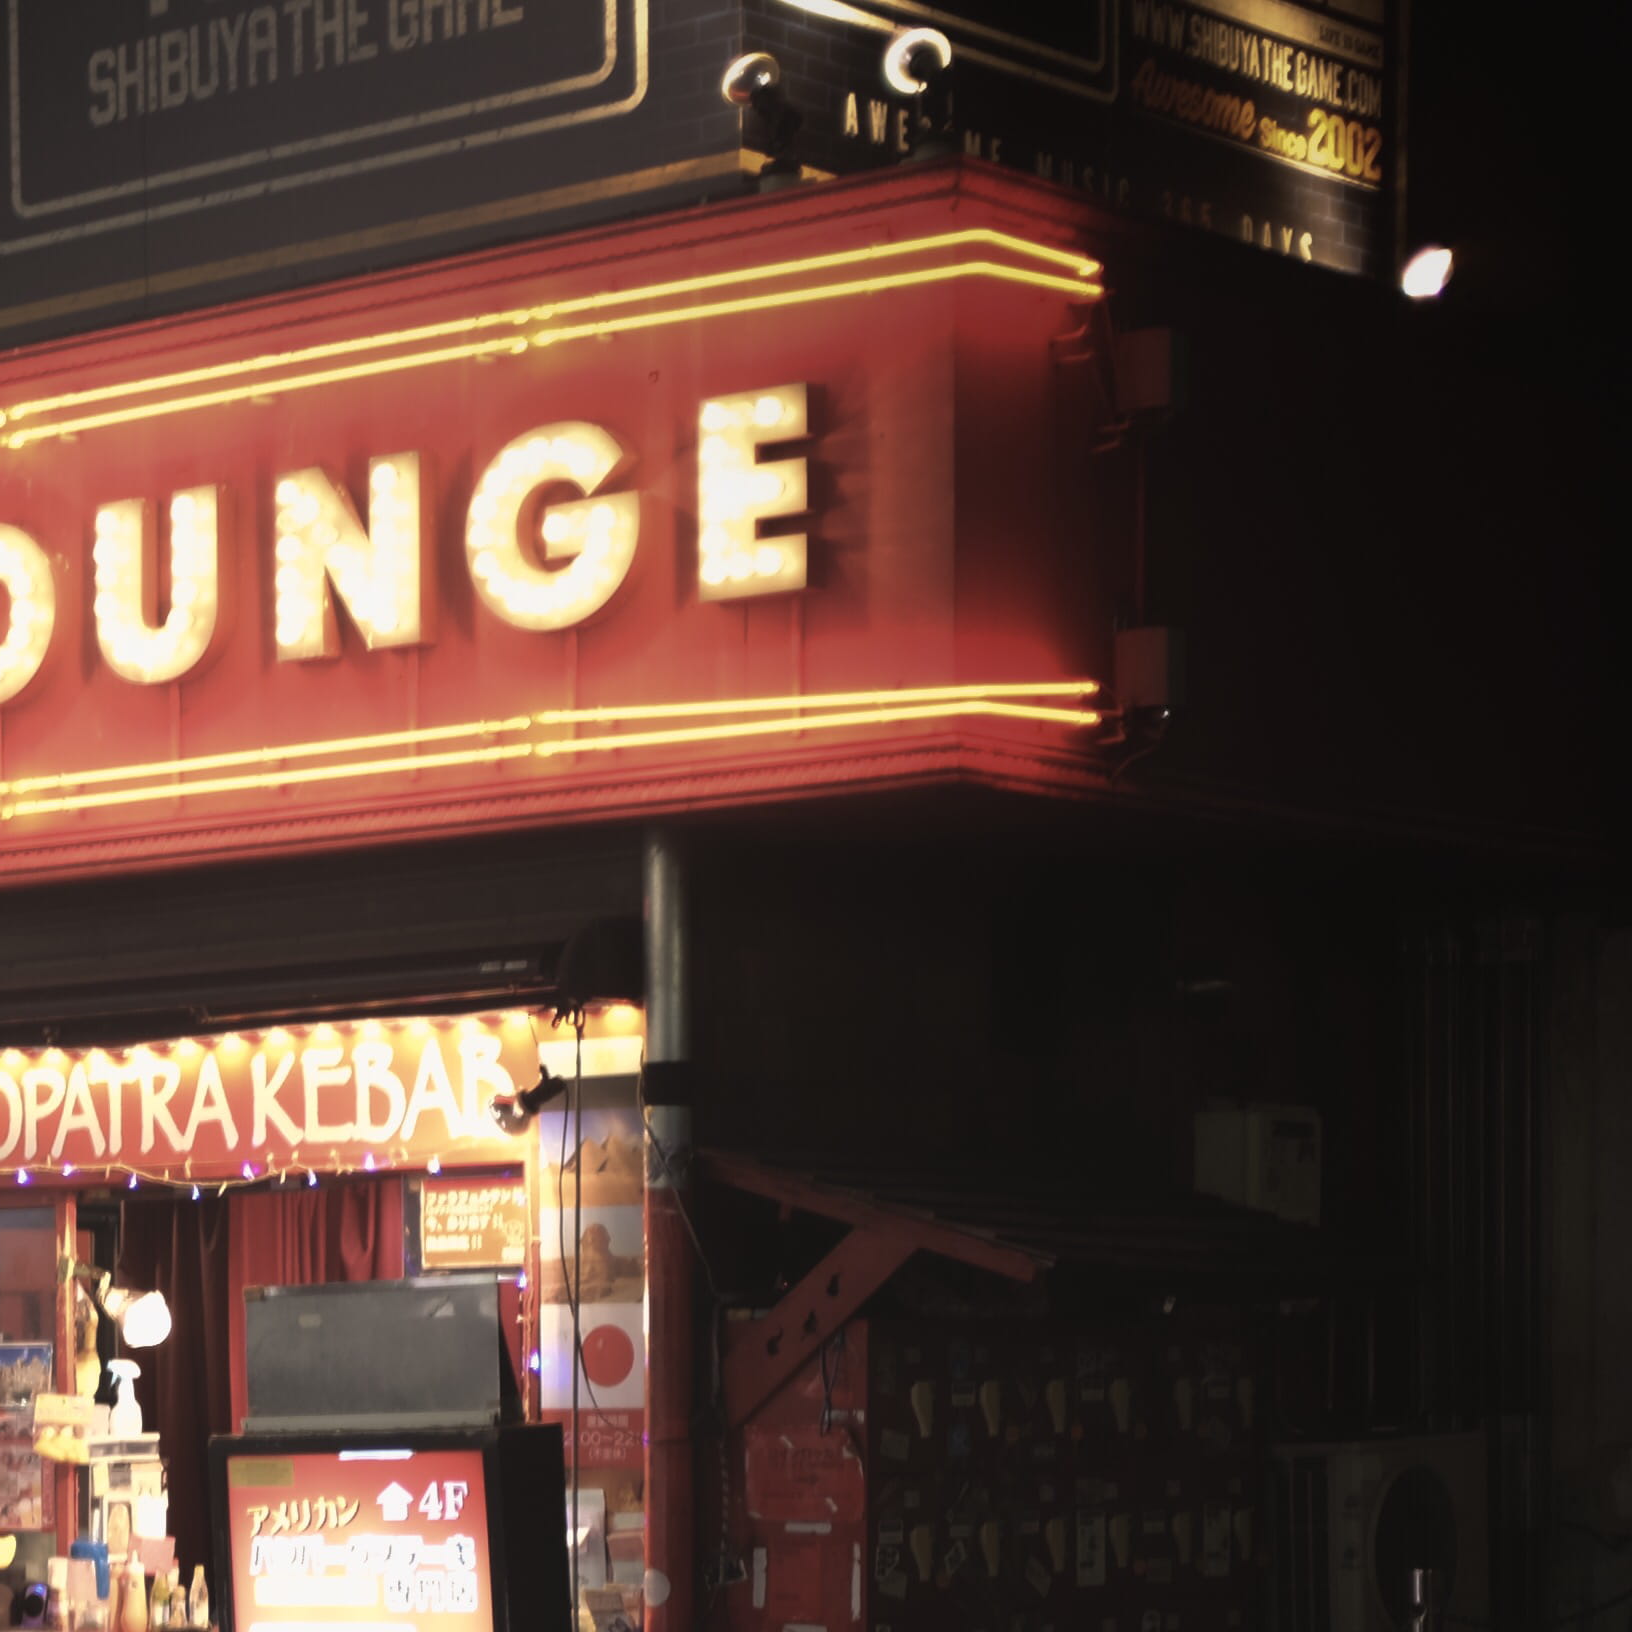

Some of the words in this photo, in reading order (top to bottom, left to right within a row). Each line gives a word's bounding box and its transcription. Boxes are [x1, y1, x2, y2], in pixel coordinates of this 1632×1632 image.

[88, 4, 279, 128] SHIBUYA
[283, 0, 379, 77] THE
[843, 92, 1003, 164] AWEME
[1259, 116, 1307, 161] Since
[1307, 107, 1385, 182] 2002
[251, 1033, 522, 1148] KEBAB
[247, 1495, 361, 1537] アメリカン
[418, 1480, 469, 1522] 4F
